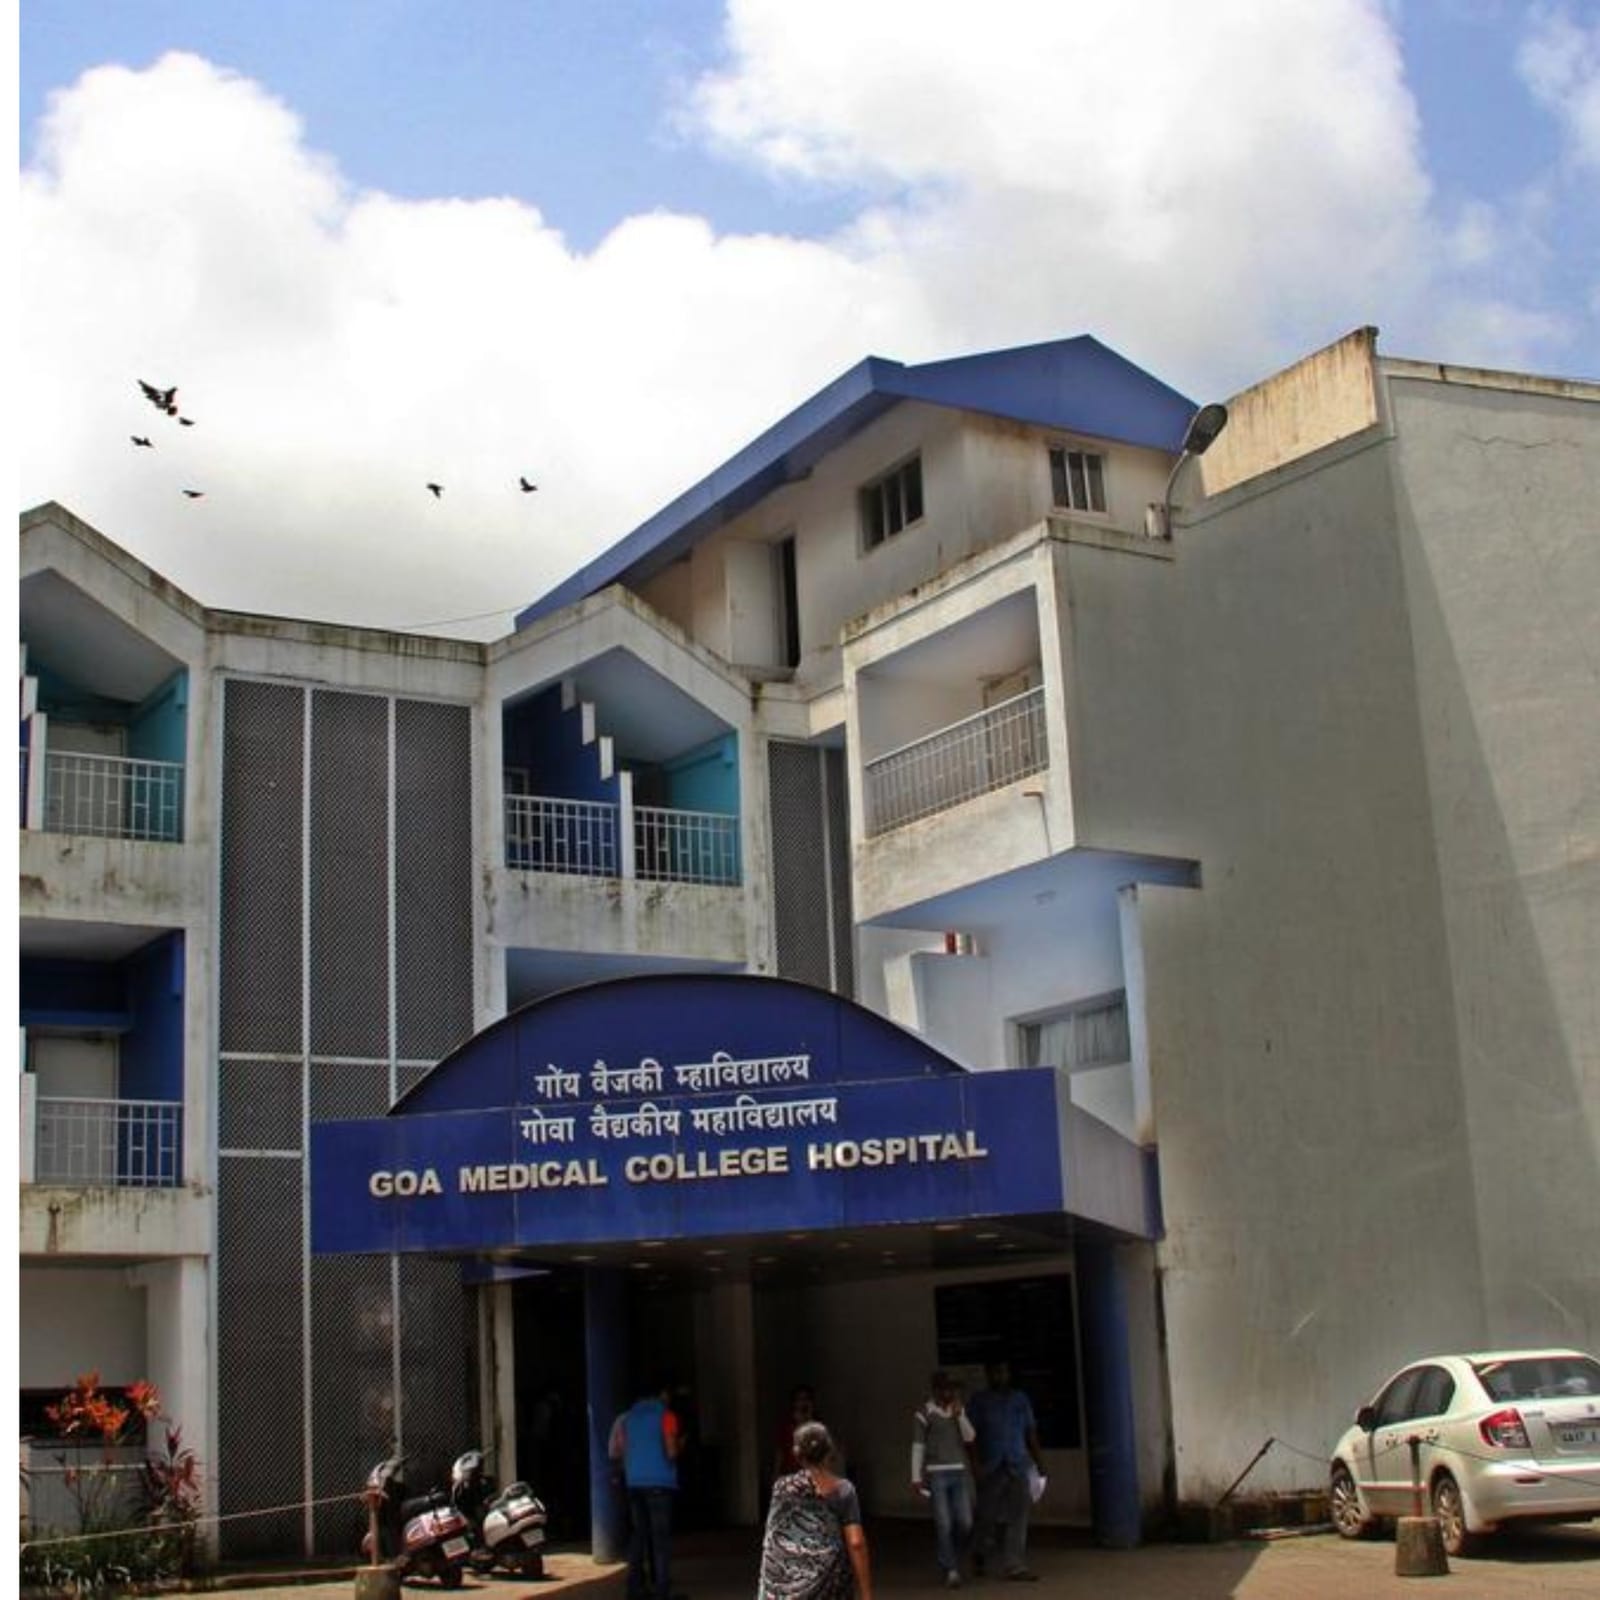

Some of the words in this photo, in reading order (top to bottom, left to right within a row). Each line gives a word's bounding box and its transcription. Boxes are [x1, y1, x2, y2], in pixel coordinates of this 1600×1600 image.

[535, 1064, 580, 1098] गोंय
[590, 1058, 663, 1094] वैजकी
[674, 1052, 809, 1090] म्हाविद्यालय
[520, 1108, 575, 1143] गोवा
[590, 1102, 681, 1138] वैद्यकीय
[690, 1095, 837, 1135] महाविद्यालय
[370, 1169, 442, 1197] GOA
[460, 1160, 608, 1193] MEDICAL
[625, 1146, 788, 1182] COLLEGE
[808, 1131, 988, 1171] HOSPITAL
